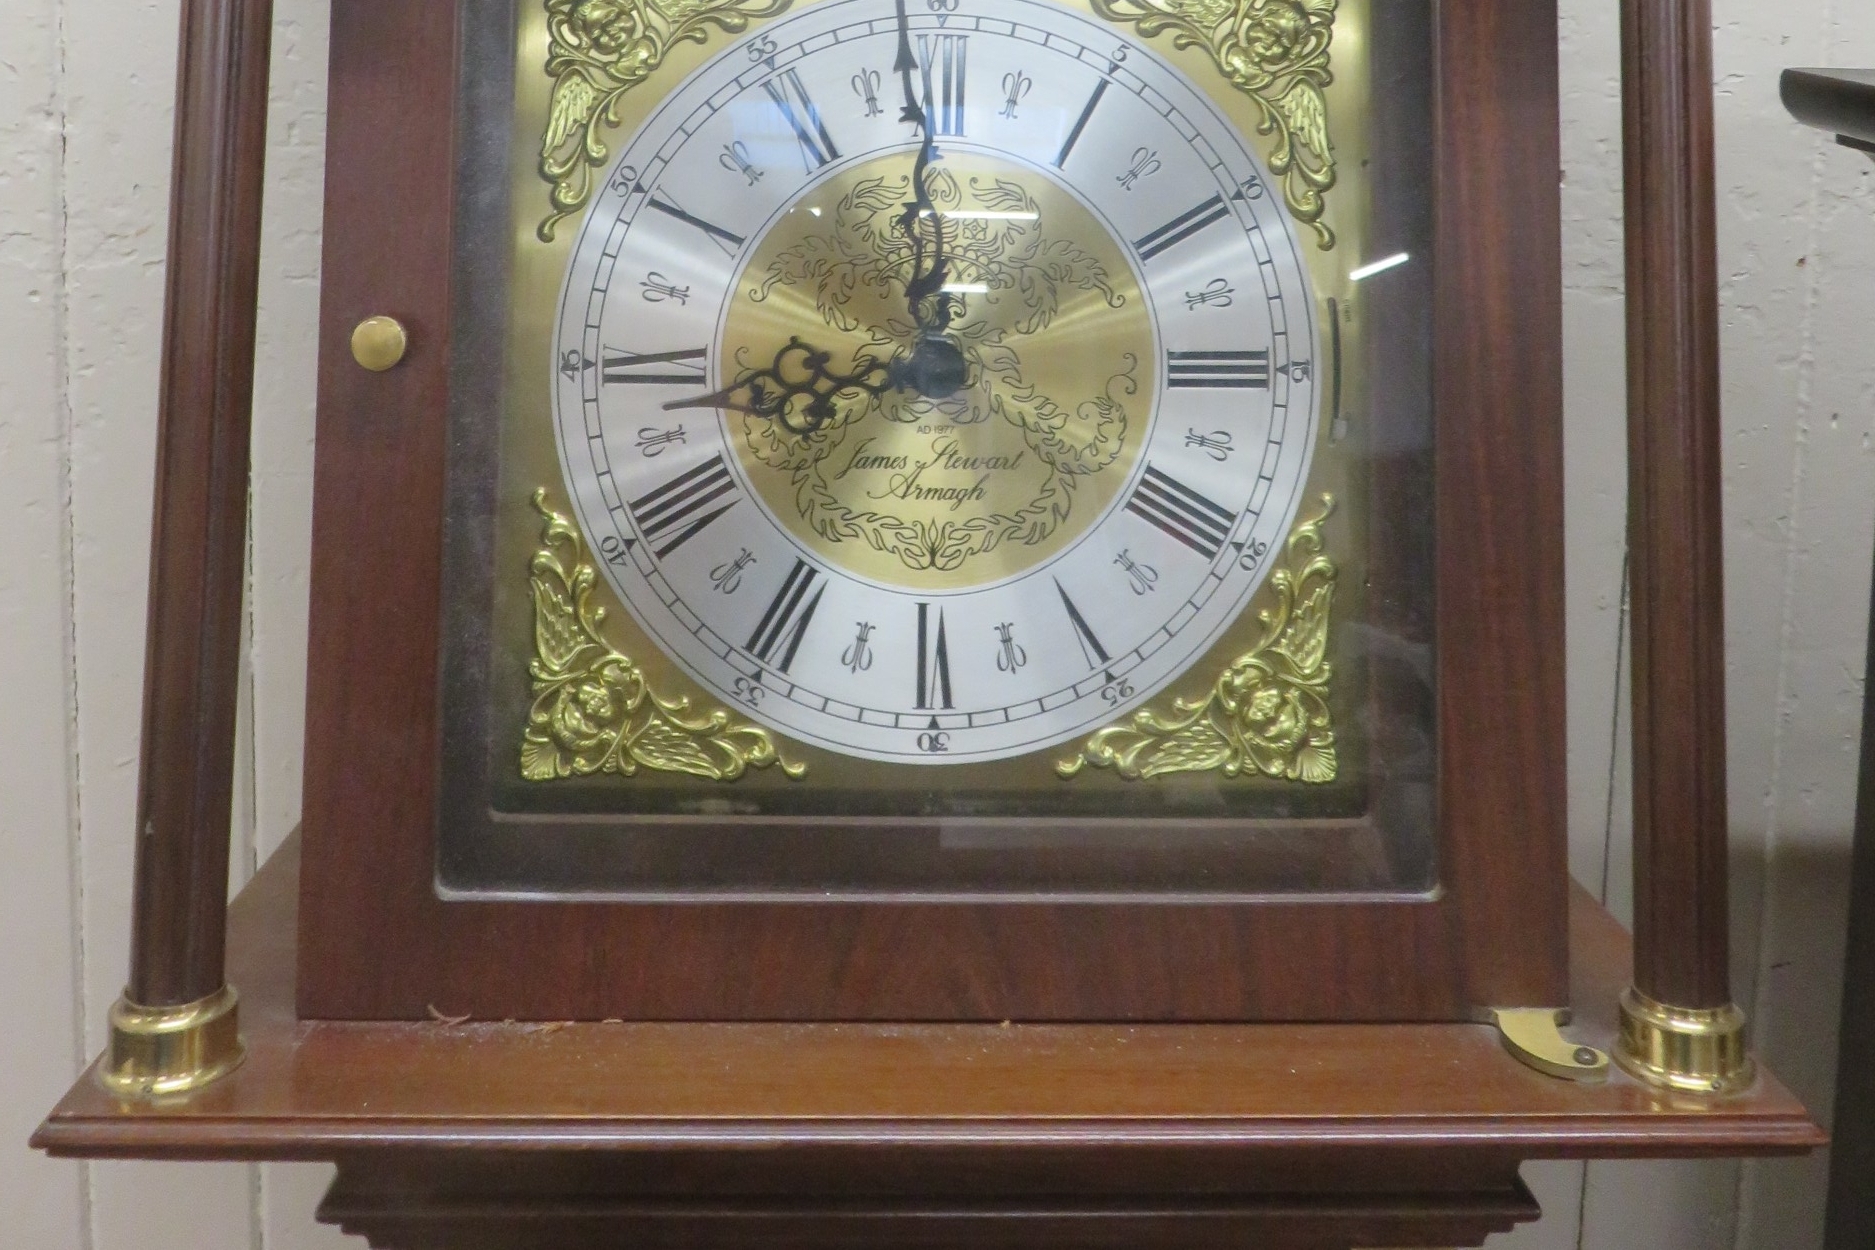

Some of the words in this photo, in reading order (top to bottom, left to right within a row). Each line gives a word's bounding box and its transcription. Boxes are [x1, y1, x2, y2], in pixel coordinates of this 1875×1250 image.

[745, 35, 779, 63] 55
[1111, 43, 1131, 63] 5
[909, 33, 971, 138] XII
[757, 66, 844, 176] XI
[1048, 75, 1114, 172] I
[610, 164, 639, 199] 50
[1239, 173, 1265, 201] 10
[644, 183, 748, 261] X
[1130, 190, 1233, 267] II
[559, 348, 582, 384] 45
[601, 342, 708, 388] IX
[1166, 346, 1270, 390] III
[1290, 359, 1313, 384] 15
[916, 425, 931, 435] AD
[833, 436, 908, 480] James
[914, 435, 1025, 471] Stewart
[626, 449, 744, 561] VIII
[866, 462, 990, 512] Armagh
[1121, 459, 1241, 563] IIII
[602, 535, 629, 569] 40
[1238, 536, 1268, 572] 20
[741, 555, 830, 676] VII
[1051, 574, 1114, 671] V
[912, 602, 956, 710] VI
[733, 675, 767, 707] 35
[1100, 676, 1135, 708] 25
[916, 732, 951, 752] 30
